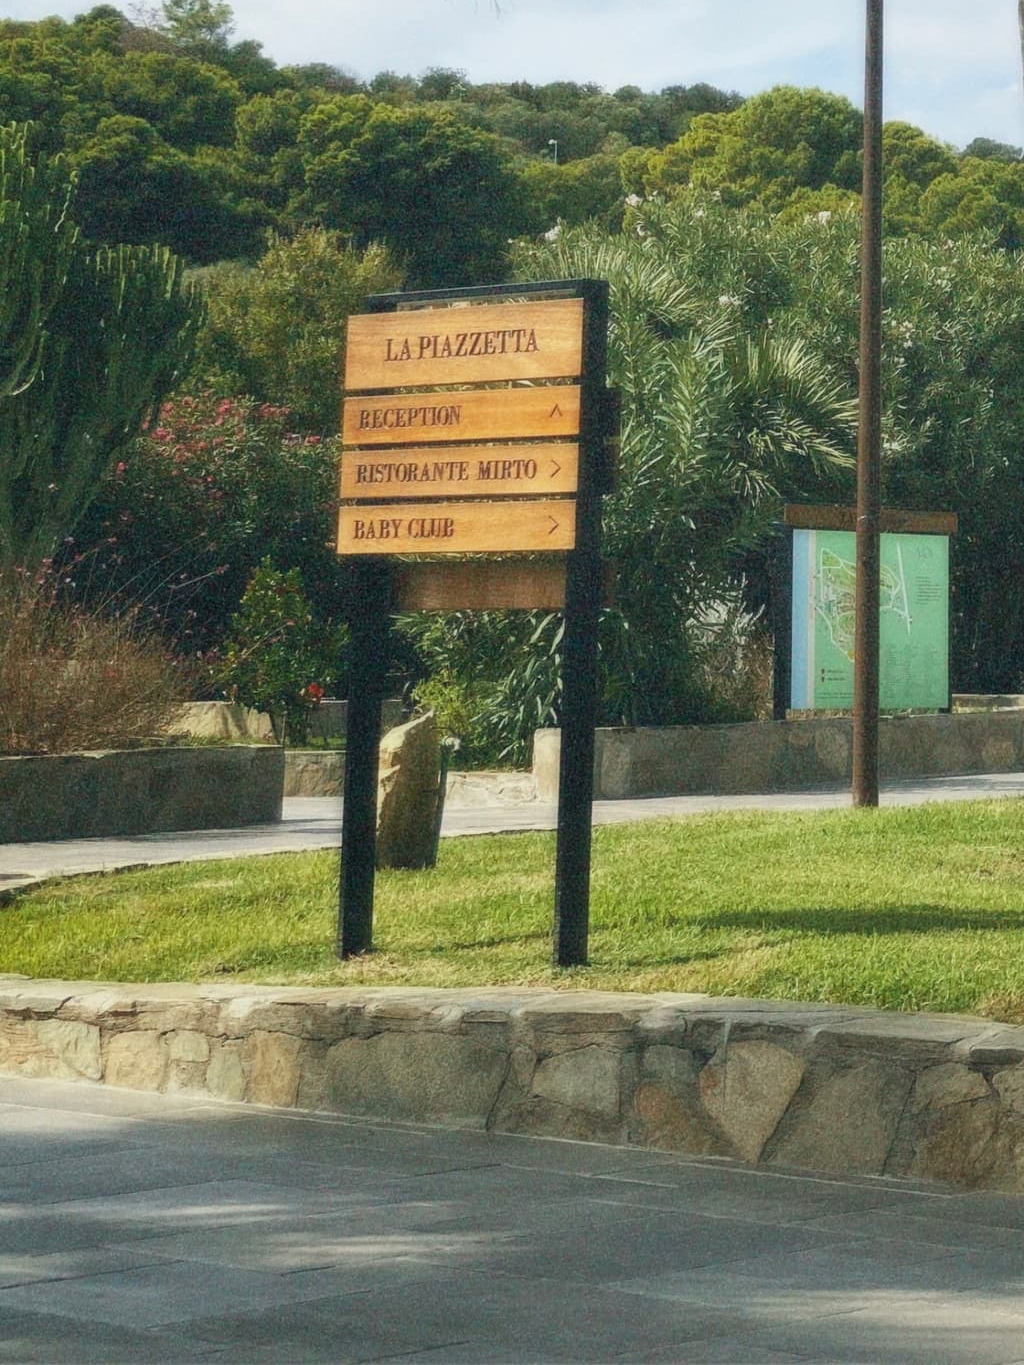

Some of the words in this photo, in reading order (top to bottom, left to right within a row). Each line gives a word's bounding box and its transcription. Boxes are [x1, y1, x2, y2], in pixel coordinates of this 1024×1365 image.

[385, 338, 411, 362] LA
[418, 329, 539, 359] PIAZZETTA
[359, 405, 461, 429] RECEPTION
[356, 462, 468, 483] RISTORANTE
[478, 459, 537, 480] MIRTO
[353, 519, 402, 539] BABY
[408, 518, 454, 538] CLUB
